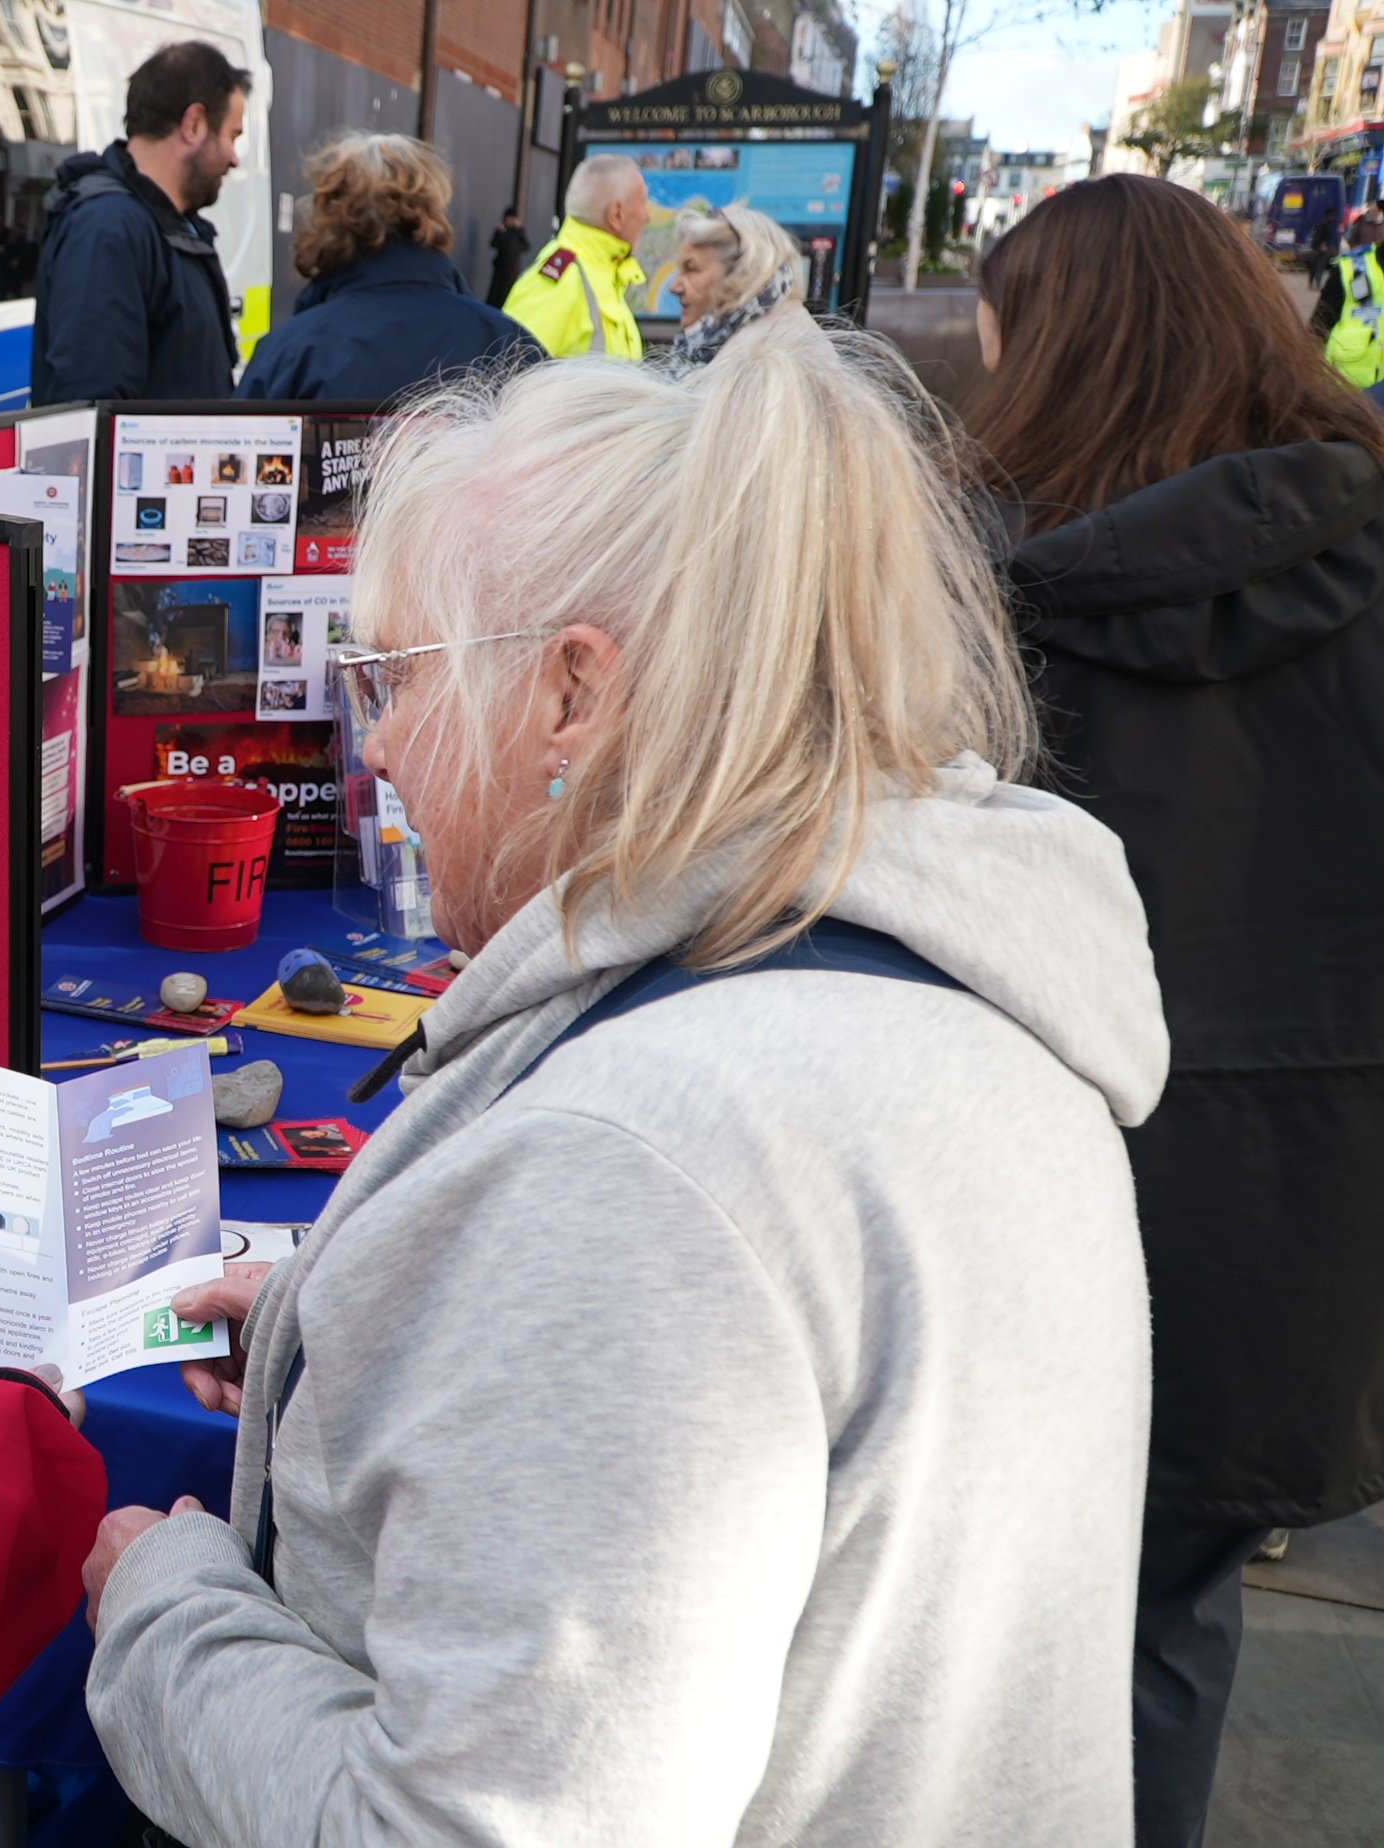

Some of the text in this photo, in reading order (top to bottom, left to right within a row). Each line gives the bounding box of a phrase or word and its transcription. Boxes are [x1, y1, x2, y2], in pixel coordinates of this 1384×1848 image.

[608, 104, 842, 123] WELCOME TO SCARBOROUGH
[121, 437, 156, 446] Sources
[169, 437, 197, 446] carbon
[270, 437, 293, 446] home
[321, 440, 333, 459] A
[334, 438, 361, 456] FIRE
[321, 453, 361, 477] START
[322, 472, 349, 496] ANY
[267, 597, 301, 606] Sources
[314, 597, 327, 606] CO
[167, 750, 236, 775] Be a
[207, 855, 266, 902] FIR
